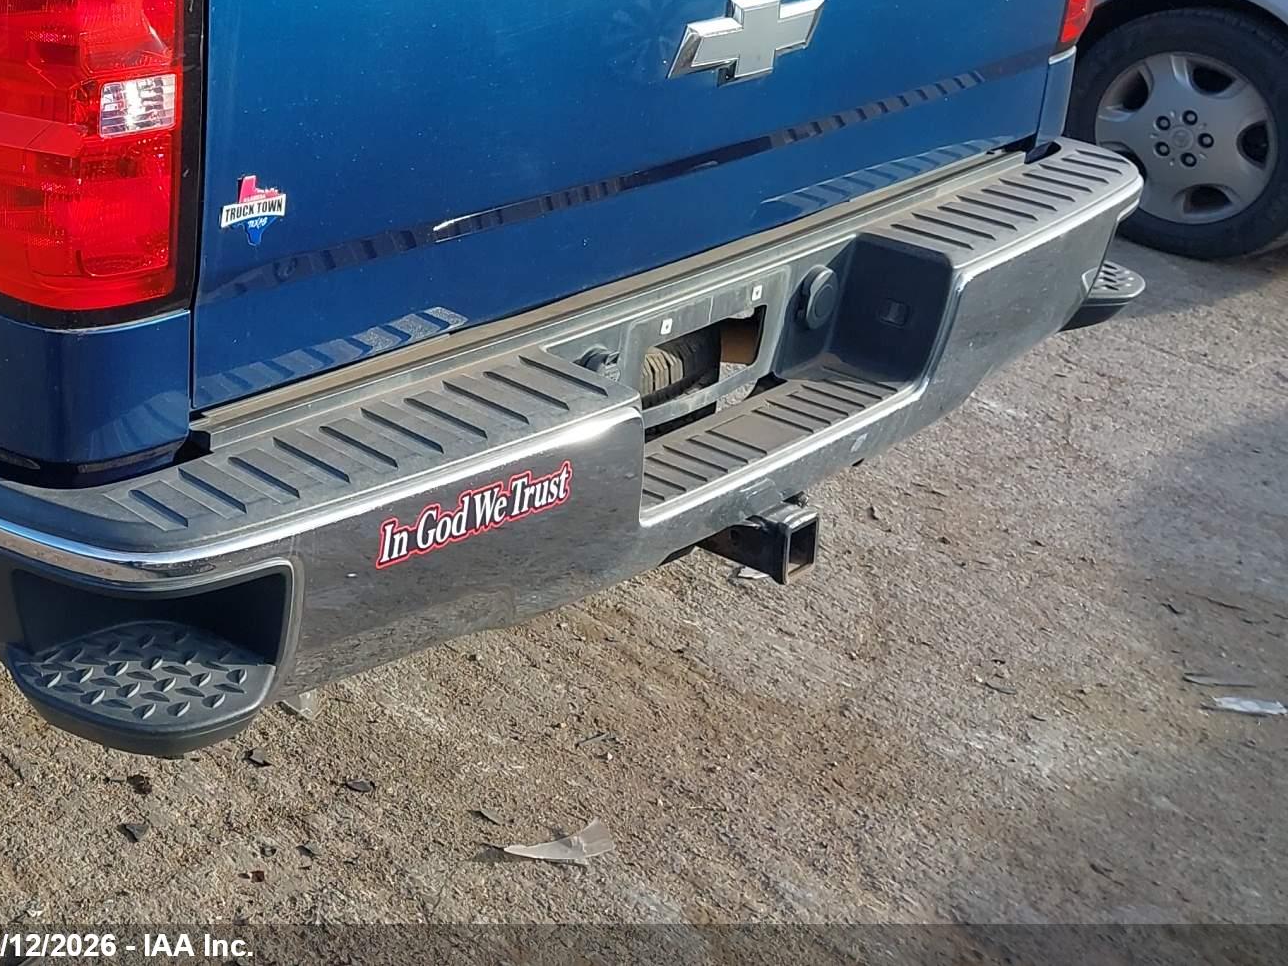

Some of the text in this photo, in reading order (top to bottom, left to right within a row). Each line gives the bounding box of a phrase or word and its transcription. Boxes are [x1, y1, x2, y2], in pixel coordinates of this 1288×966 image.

[225, 204, 255, 222] TRUCK
[257, 198, 283, 214] TOWN
[380, 464, 570, 563] In God We Trust
